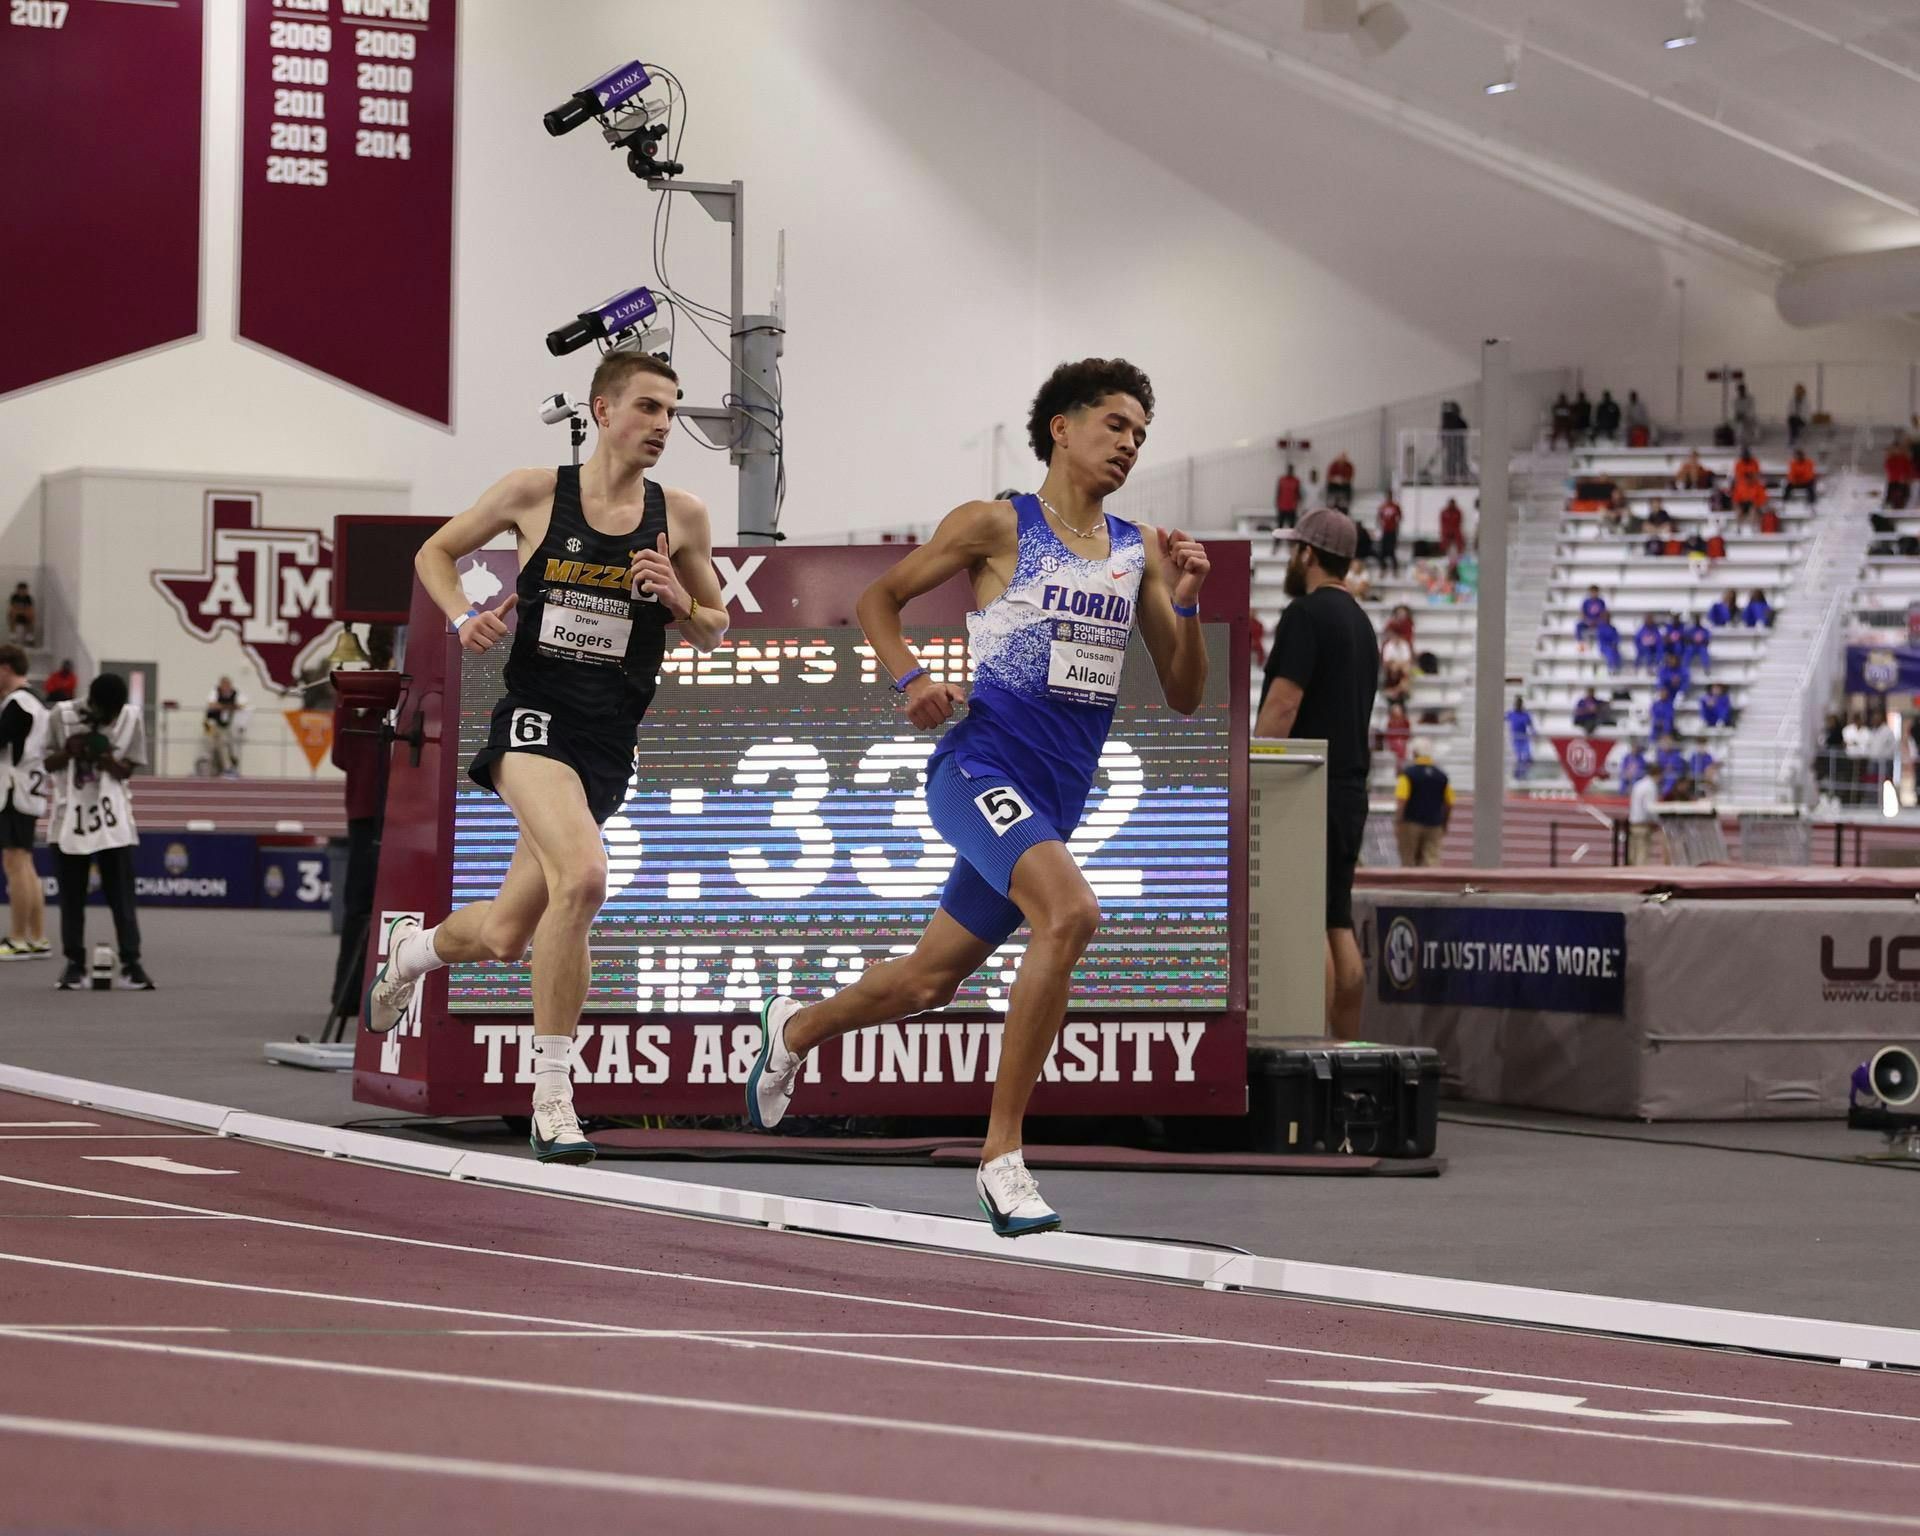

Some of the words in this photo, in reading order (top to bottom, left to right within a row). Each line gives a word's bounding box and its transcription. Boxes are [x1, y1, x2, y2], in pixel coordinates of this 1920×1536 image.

[10, 0, 69, 29] 2017
[270, 21, 332, 52] 2009
[355, 29, 416, 60] 2009
[272, 55, 329, 86] 2010
[357, 63, 413, 93] 2010
[610, 71, 640, 94] LYNX
[274, 89, 325, 119] 2011
[359, 97, 409, 126] 2011
[270, 123, 328, 153] 2013
[355, 130, 412, 160] 2014
[266, 156, 328, 186] 2025
[615, 297, 647, 319] LYNX
[566, 537, 582, 553] SEC
[564, 597, 629, 616] CONFERENCE
[565, 590, 630, 609] SOUTHEASTERN
[575, 614, 599, 626] Drew
[553, 625, 613, 648] Rogers
[1073, 631, 1125, 647] CONFERENCE
[1076, 648, 1114, 663] Oussama
[1066, 664, 1116, 687] Allaoui
[515, 712, 543, 742] 6
[74, 796, 117, 836] 138
[982, 789, 1022, 826] 5
[1423, 941, 1438, 969] IT
[1441, 942, 1485, 972] JUST
[1488, 943, 1550, 974] MEANS
